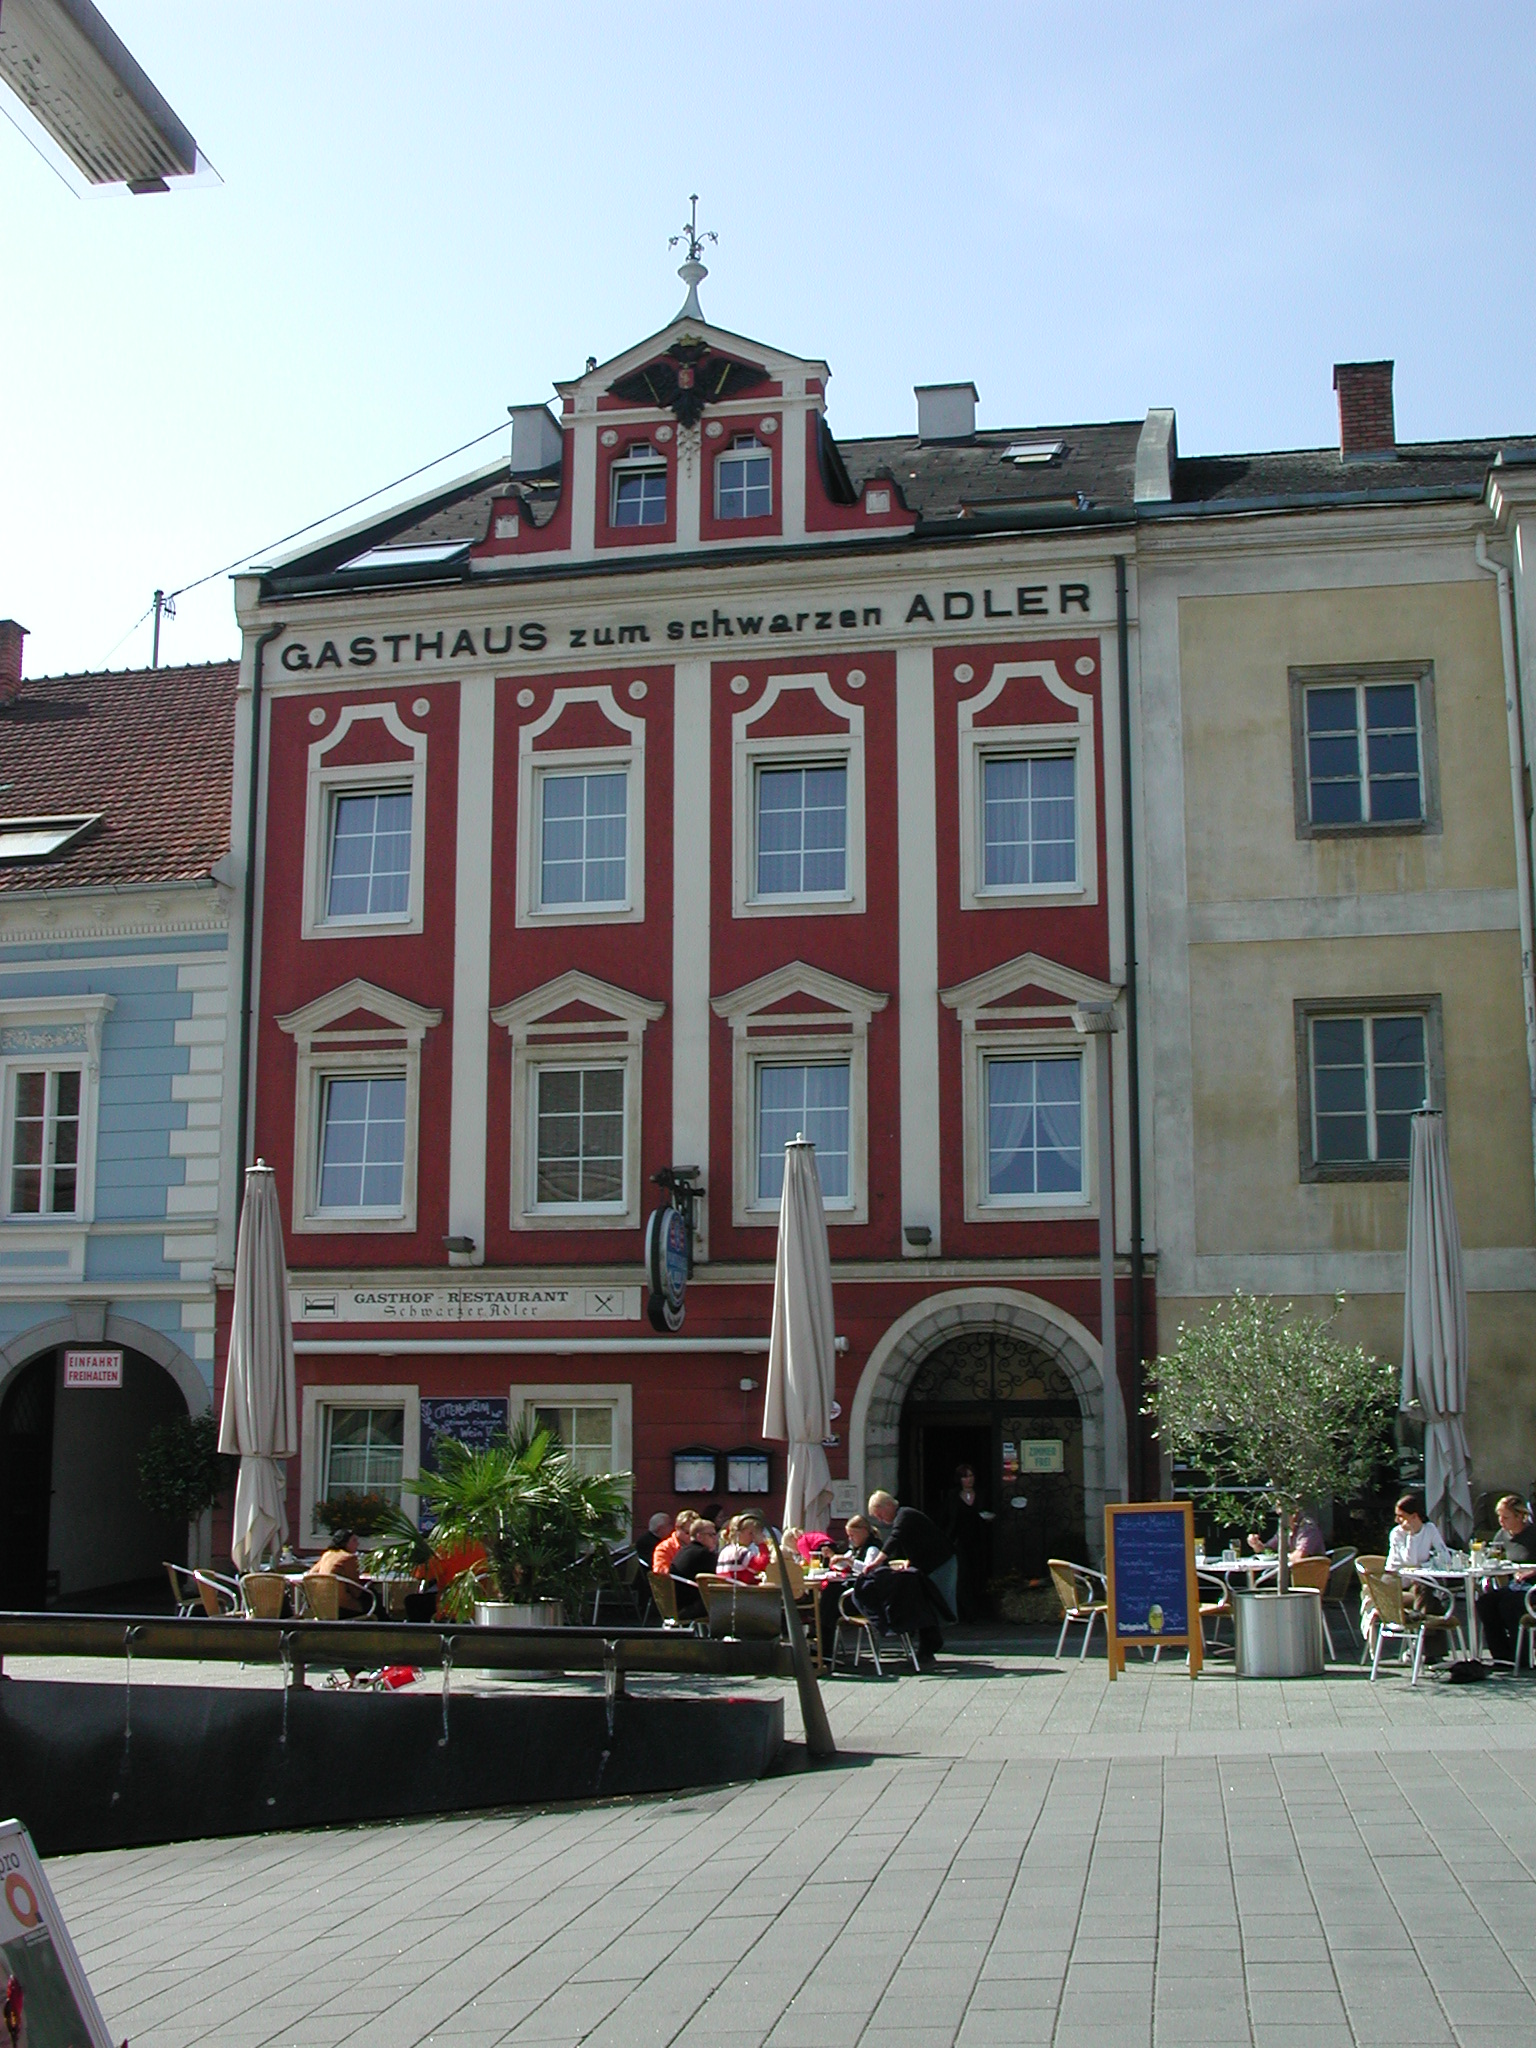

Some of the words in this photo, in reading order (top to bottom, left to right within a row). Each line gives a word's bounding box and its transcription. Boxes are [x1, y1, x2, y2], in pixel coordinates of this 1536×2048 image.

[280, 622, 548, 672] GASTHAUS
[568, 624, 651, 648] zum
[666, 607, 882, 641] schwarzen
[905, 582, 1091, 623] ADLER
[354, 1292, 435, 1304] GASTHOF
[447, 1291, 569, 1303] RESTAURANT
[383, 1304, 484, 1320] Schwarzer
[489, 1303, 538, 1317] Adler
[69, 1356, 119, 1367] EINFAHRT
[68, 1370, 118, 1381] FREIHALTEN
